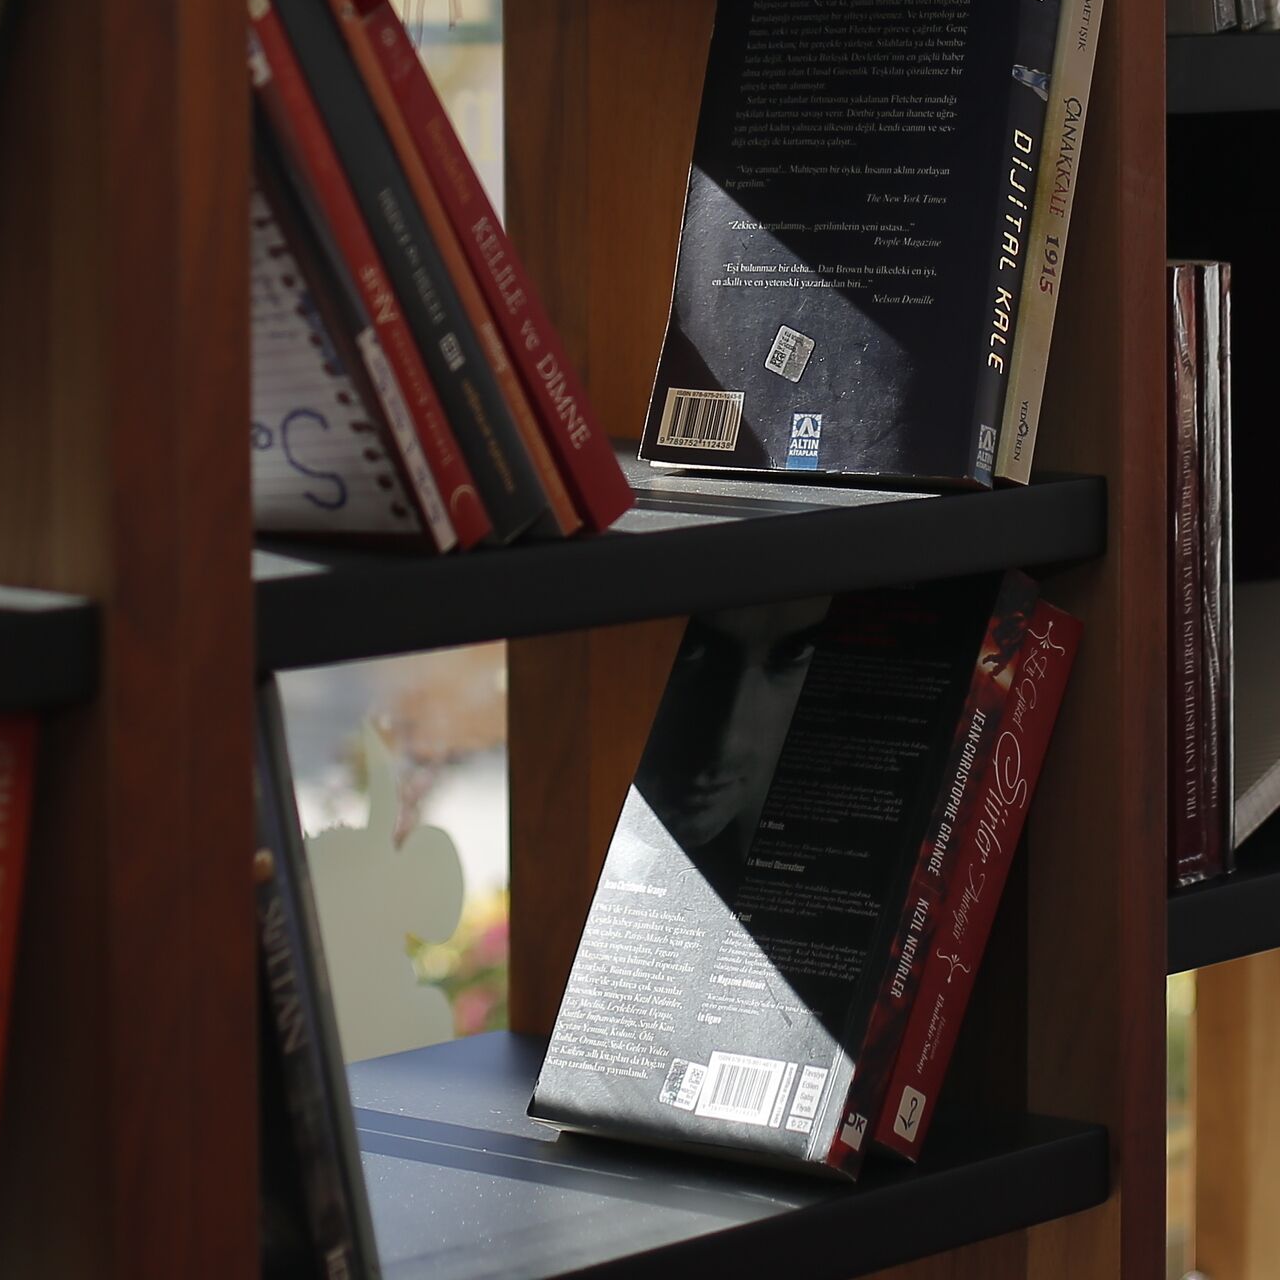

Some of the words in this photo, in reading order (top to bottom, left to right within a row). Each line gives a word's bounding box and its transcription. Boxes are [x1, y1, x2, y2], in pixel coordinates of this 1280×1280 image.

[1048, 96, 1083, 218] ÇANAKKALE
[829, 166, 840, 174] bir
[867, 194, 879, 203] The
[884, 194, 900, 203] New
[903, 194, 920, 204] York
[922, 195, 946, 204] Times
[999, 128, 1033, 272] DİJİTAL
[873, 237, 900, 247] People
[902, 238, 941, 248] Magazine
[740, 264, 776, 273] bulunmaz
[778, 264, 789, 273] bir
[818, 265, 833, 273] Dan
[836, 265, 862, 274] Brown
[864, 265, 874, 273] bu
[876, 264, 909, 275] ülkedeki
[1039, 233, 1060, 297] 1915
[764, 278, 798, 289] yetenekli
[872, 294, 899, 304] Nelson
[901, 295, 934, 305] Demille
[987, 285, 1013, 376] KALE
[669, 438, 698, 446] 789752
[790, 438, 819, 450] ALTIN
[944, 707, 987, 823] JEAN-CHRISTOPHE
[760, 820, 767, 829] Le
[927, 822, 953, 877] GRANGÉ
[909, 897, 930, 934] KIZIL
[890, 935, 919, 1000] NEHİRLER
